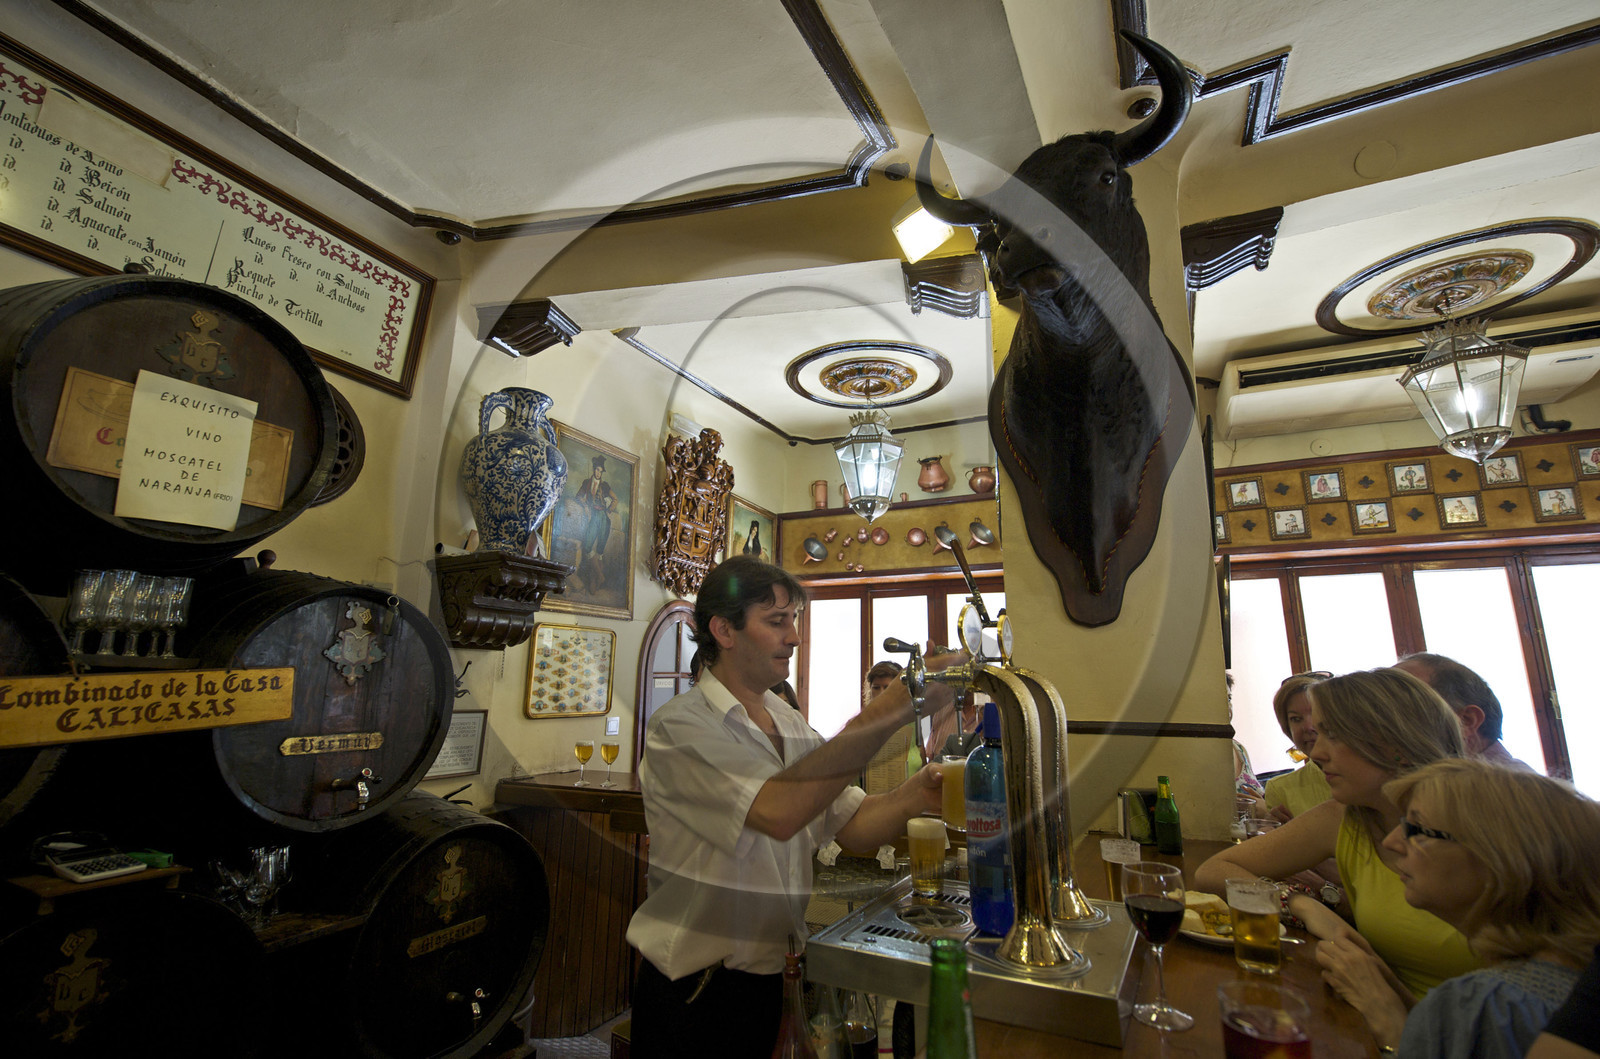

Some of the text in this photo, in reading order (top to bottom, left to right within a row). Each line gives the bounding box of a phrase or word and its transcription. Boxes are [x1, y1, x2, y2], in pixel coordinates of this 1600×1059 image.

[65, 141, 80, 155] de
[75, 187, 132, 222] Salmón
[62, 206, 127, 240] Aguacate
[128, 239, 142, 249] con
[142, 237, 186, 268] Jamón
[141, 255, 185, 281] Salm
[242, 226, 276, 252] Queso
[316, 268, 332, 281] con
[333, 273, 370, 300] Salmón
[225, 267, 323, 327] Pincho de Tortilla
[326, 288, 366, 313] Anchoas
[160, 391, 240, 419] EXQUISITO
[186, 427, 222, 443] VINO
[143, 448, 222, 472] MOSCATEL
[139, 478, 212, 499] NARANJA
[180, 470, 200, 481] DE
[0, 673, 283, 710] Combinado de la Casa
[56, 698, 236, 733] CALICASAS
